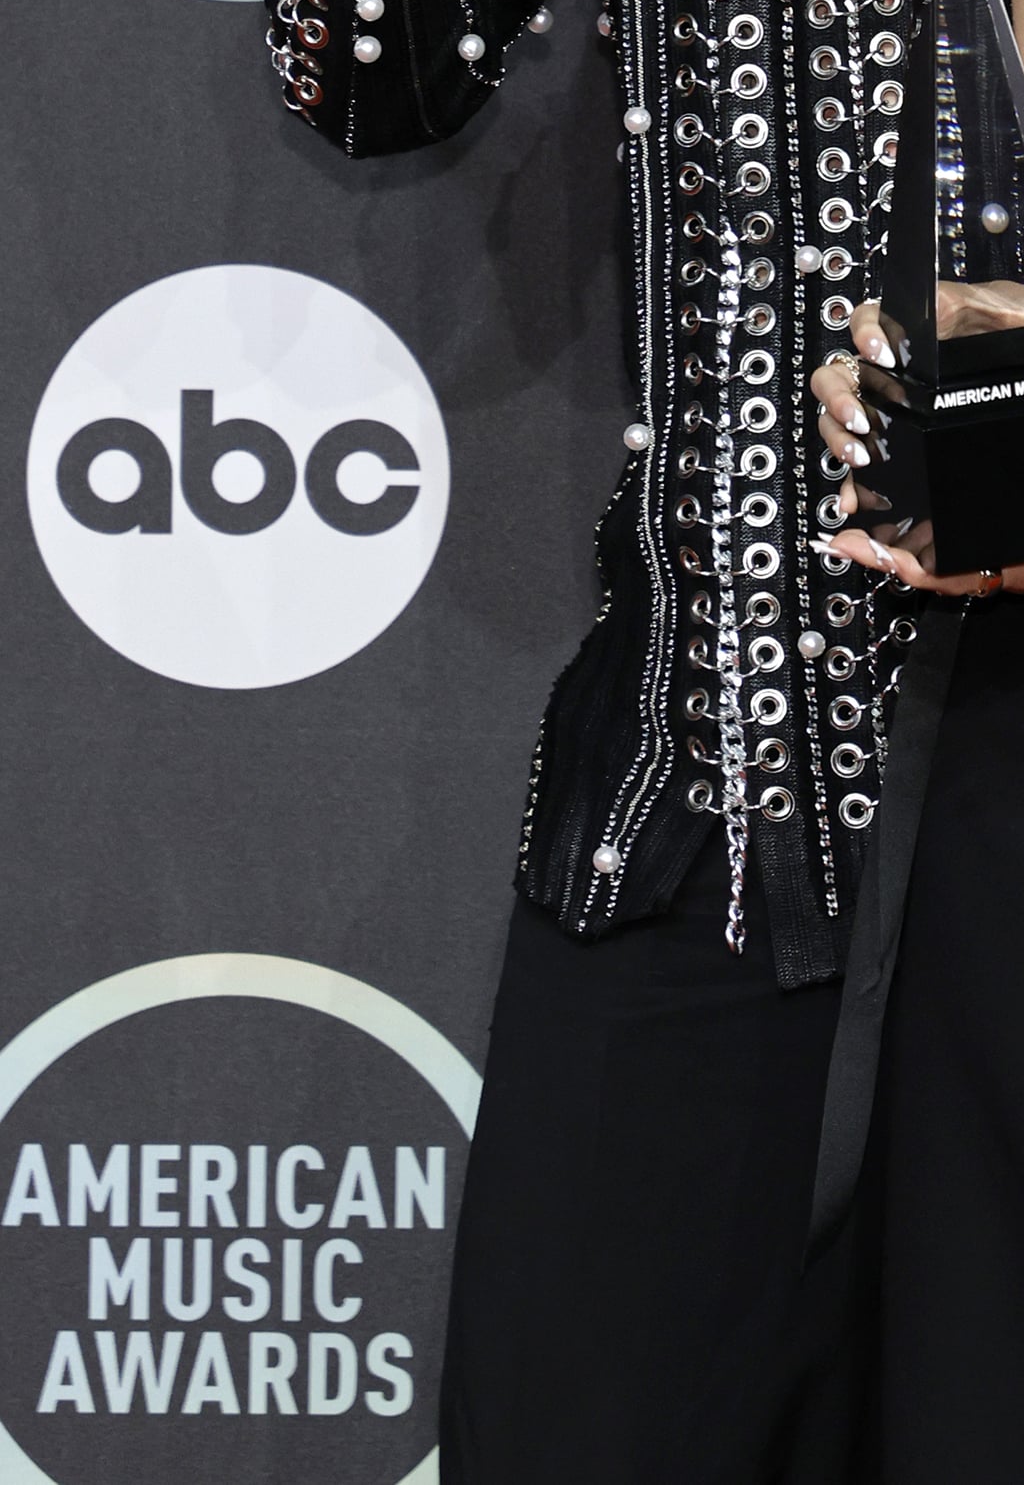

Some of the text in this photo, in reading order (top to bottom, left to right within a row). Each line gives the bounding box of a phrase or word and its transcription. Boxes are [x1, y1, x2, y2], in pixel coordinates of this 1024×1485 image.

[934, 384, 1012, 410] AMERICAN
[56, 389, 421, 537] abc
[2, 1144, 446, 1229] AMERICAN
[88, 1237, 364, 1323] MUSIC
[37, 1331, 414, 1417] AWARDS
